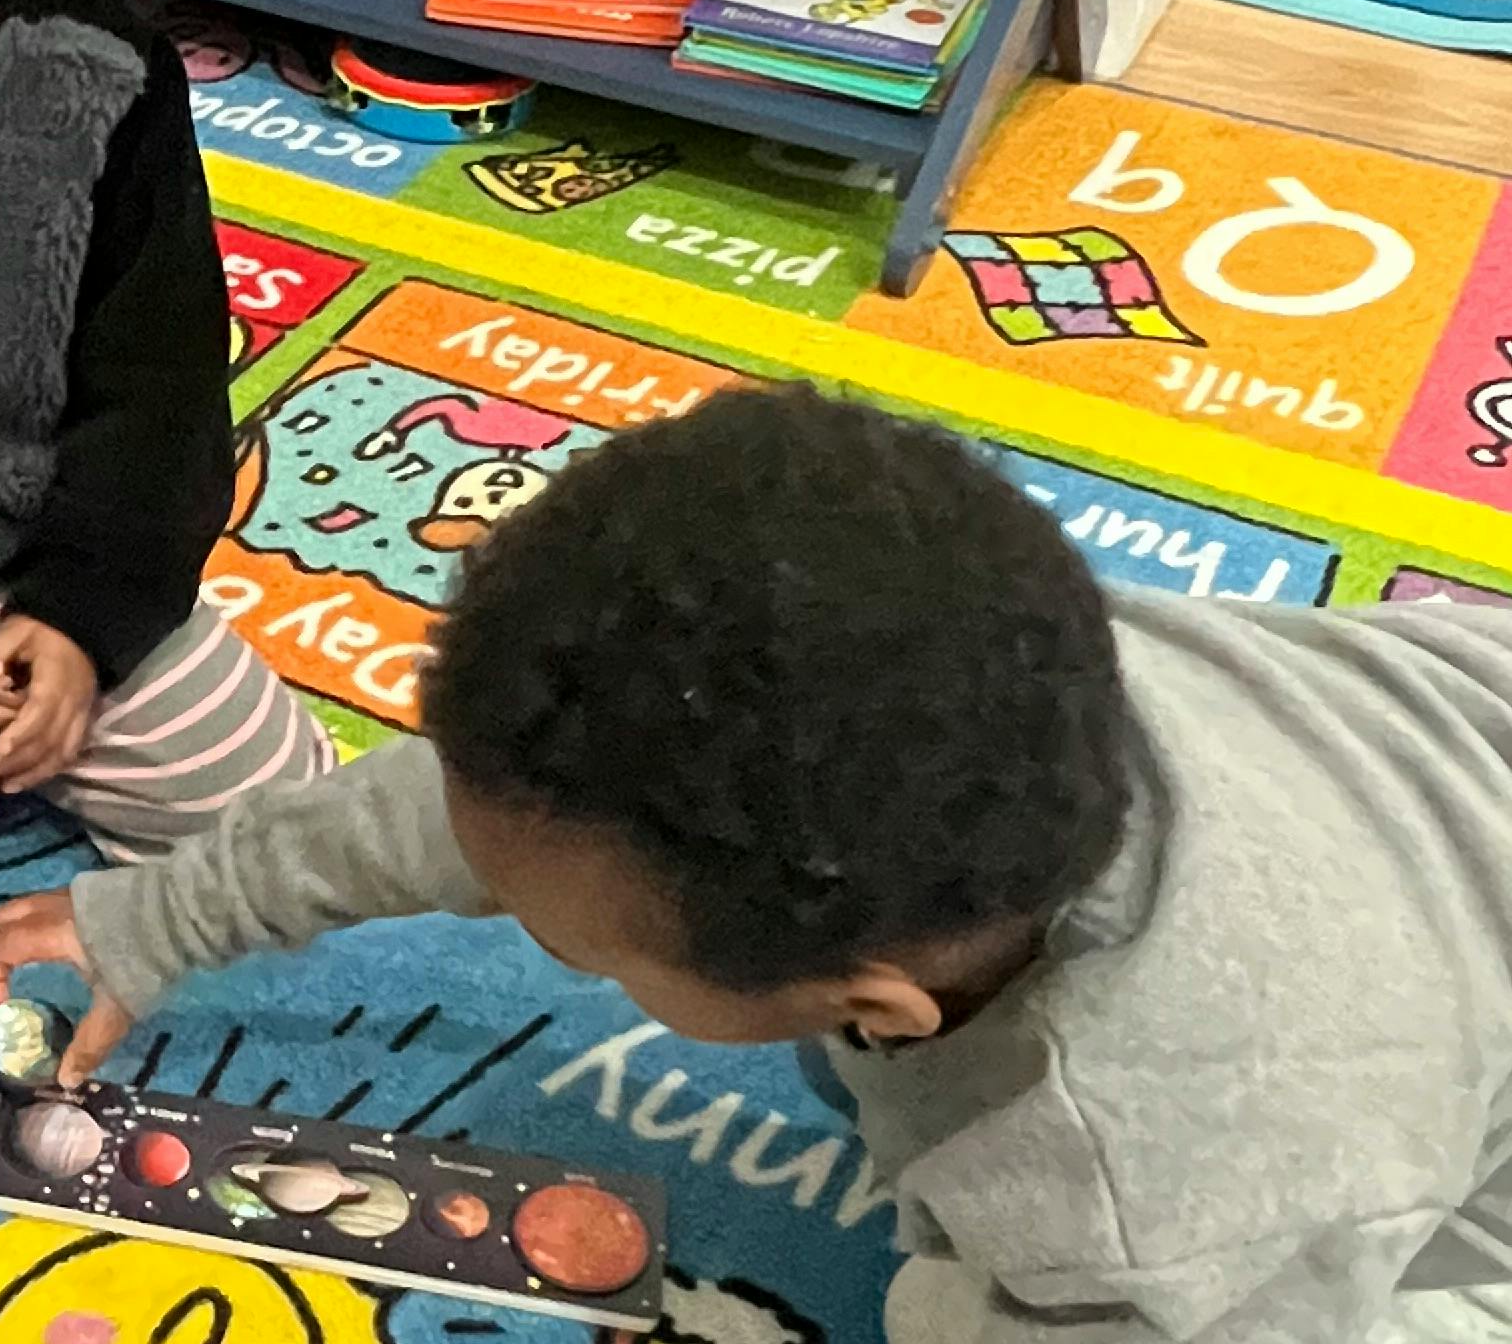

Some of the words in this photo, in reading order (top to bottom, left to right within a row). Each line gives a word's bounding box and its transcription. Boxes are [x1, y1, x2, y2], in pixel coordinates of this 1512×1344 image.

[188, 88, 403, 169] octopu
[624, 212, 847, 288] pizza
[1155, 348, 1366, 433] quilt
[535, 1018, 899, 1229] unny
